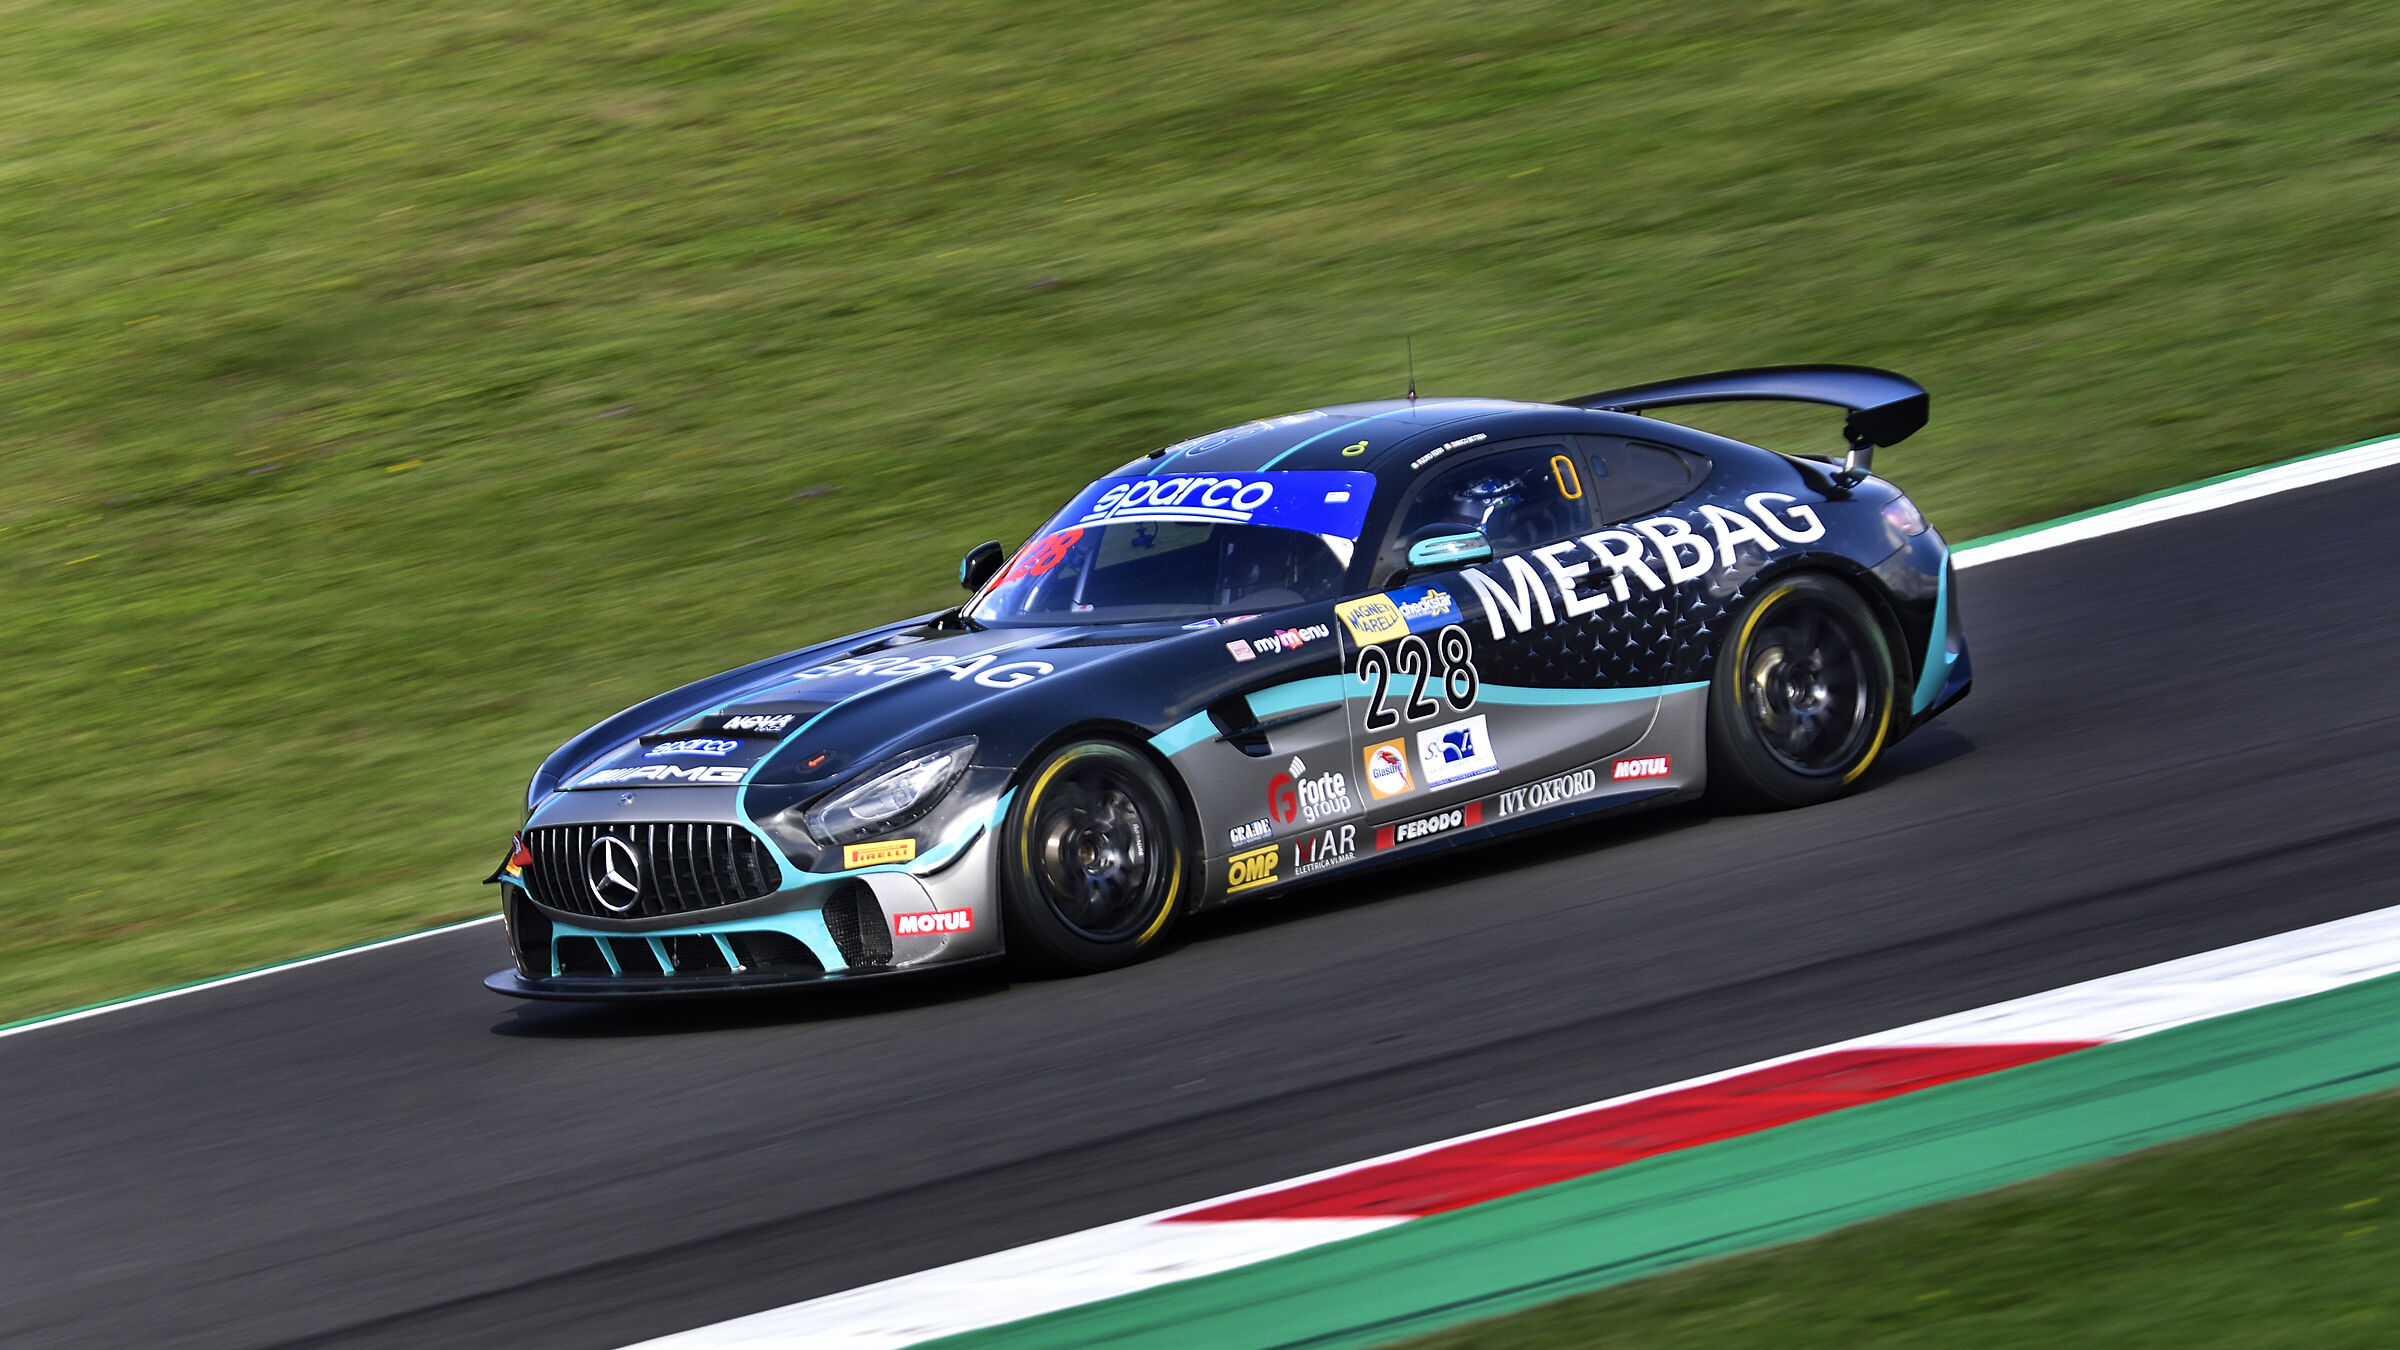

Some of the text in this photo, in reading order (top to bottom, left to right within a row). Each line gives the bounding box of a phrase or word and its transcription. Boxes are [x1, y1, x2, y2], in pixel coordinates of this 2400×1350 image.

[1090, 476, 1274, 521] sparco
[987, 527, 1085, 592] 28
[1459, 491, 1827, 641] MERBAG
[1398, 594, 1452, 617] checkstar
[792, 654, 1056, 689] ERBAG
[1356, 624, 1480, 733] 228
[722, 713, 796, 730] NOVA
[648, 738, 739, 756] sparco
[615, 764, 749, 783] AMG
[1613, 757, 1668, 778] MOTUL
[1297, 771, 1347, 808] forte
[1499, 768, 1596, 817] IVY OXFORD
[1302, 795, 1352, 823] group
[1397, 808, 1464, 842] FERODO
[852, 844, 908, 863] PIRELLI
[1228, 850, 1279, 887] OMP
[1295, 859, 1331, 876] ELETTRICA
[898, 910, 970, 934] MOTUL
